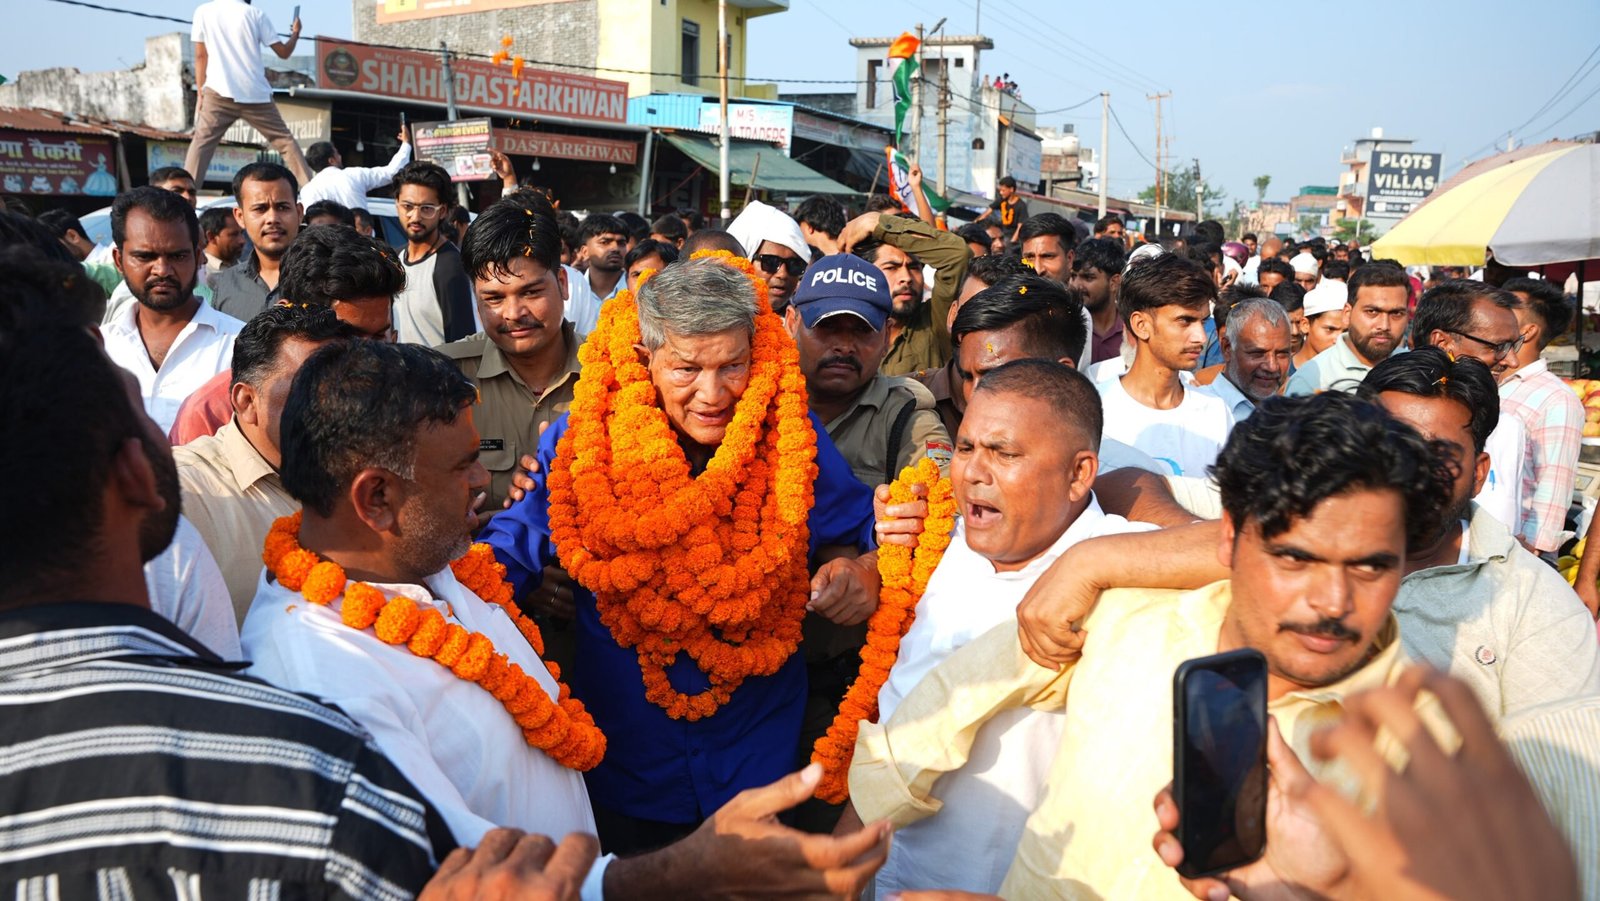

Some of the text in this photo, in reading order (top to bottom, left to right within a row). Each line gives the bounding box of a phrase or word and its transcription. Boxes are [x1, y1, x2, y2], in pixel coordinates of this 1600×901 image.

[454, 70, 625, 120] DASTARKHWAN
[737, 109, 754, 121] M/S
[503, 137, 633, 161] DASTARKHWAN
[1379, 153, 1432, 170] PLOTS
[1374, 173, 1435, 191] VILLAS
[810, 267, 877, 293] POLICE
